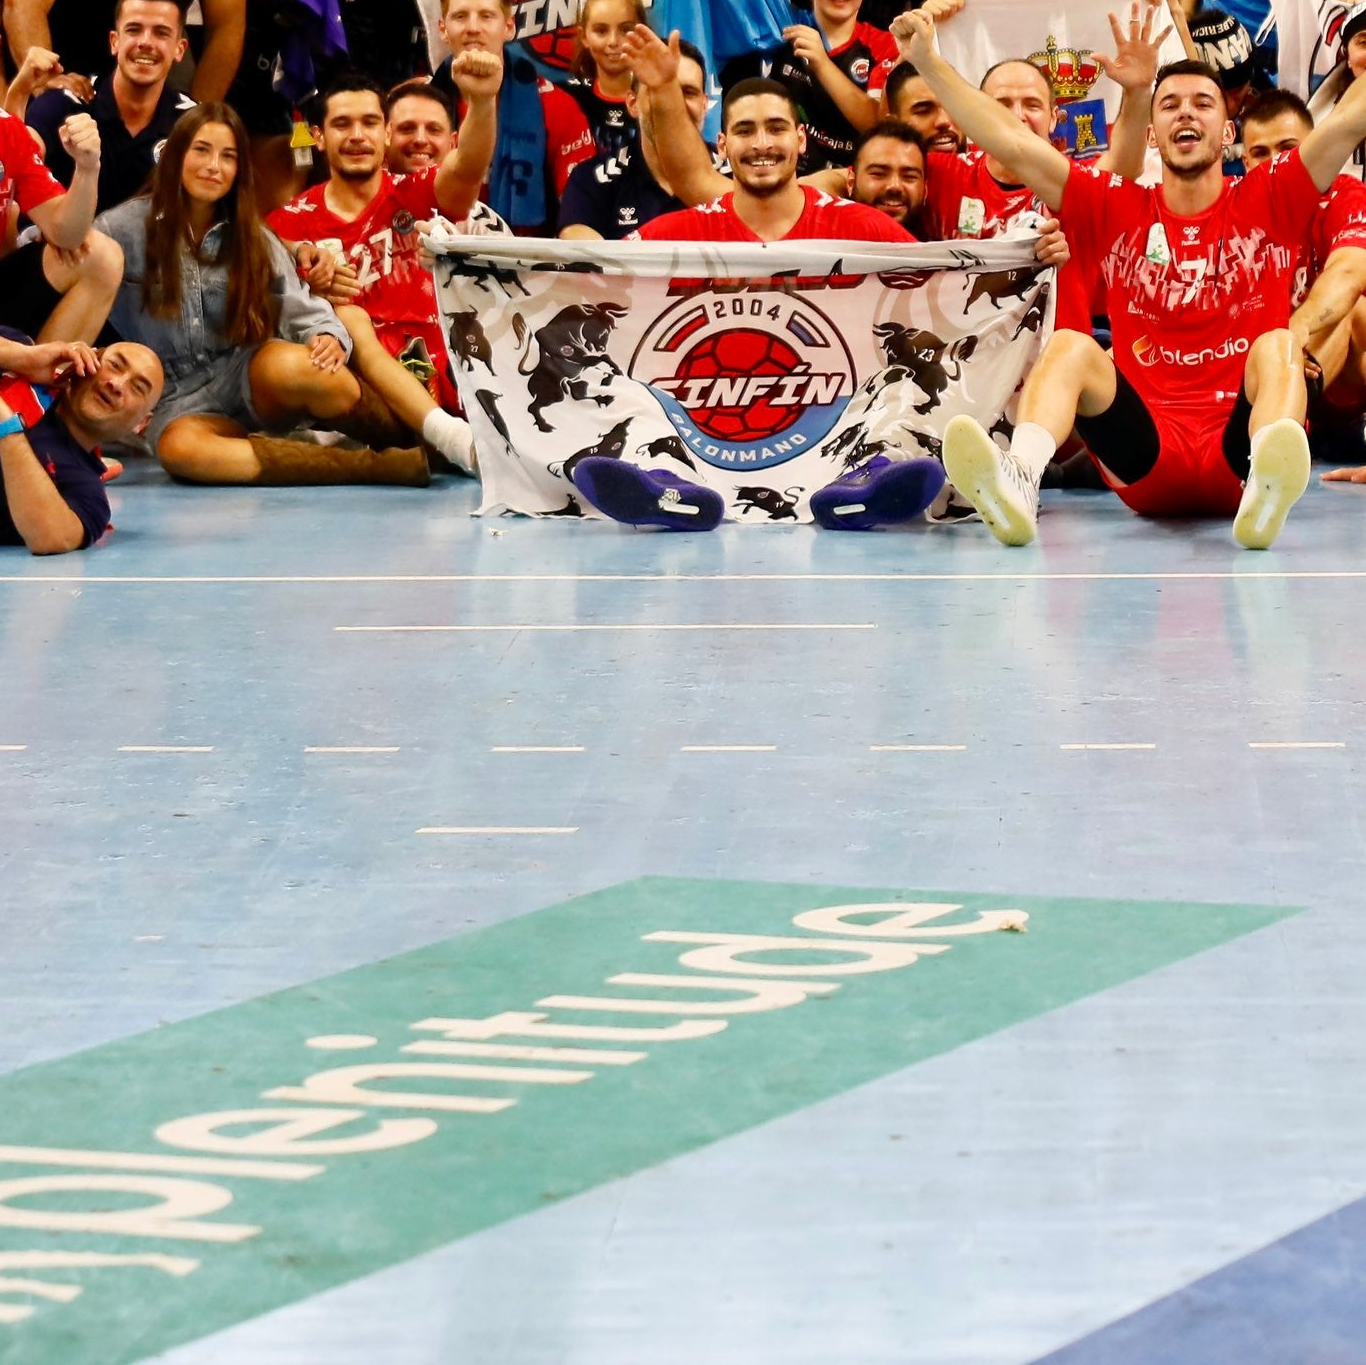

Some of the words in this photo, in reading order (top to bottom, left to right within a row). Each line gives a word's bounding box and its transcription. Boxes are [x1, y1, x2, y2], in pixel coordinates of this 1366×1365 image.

[350, 227, 393, 287] 27
[1007, 270, 1017, 281] 12
[1180, 257, 1208, 305] 7
[713, 298, 781, 322] 2004
[918, 347, 935, 363] 23
[1160, 336, 1249, 366] blendio
[671, 412, 808, 463] BALONMANO
